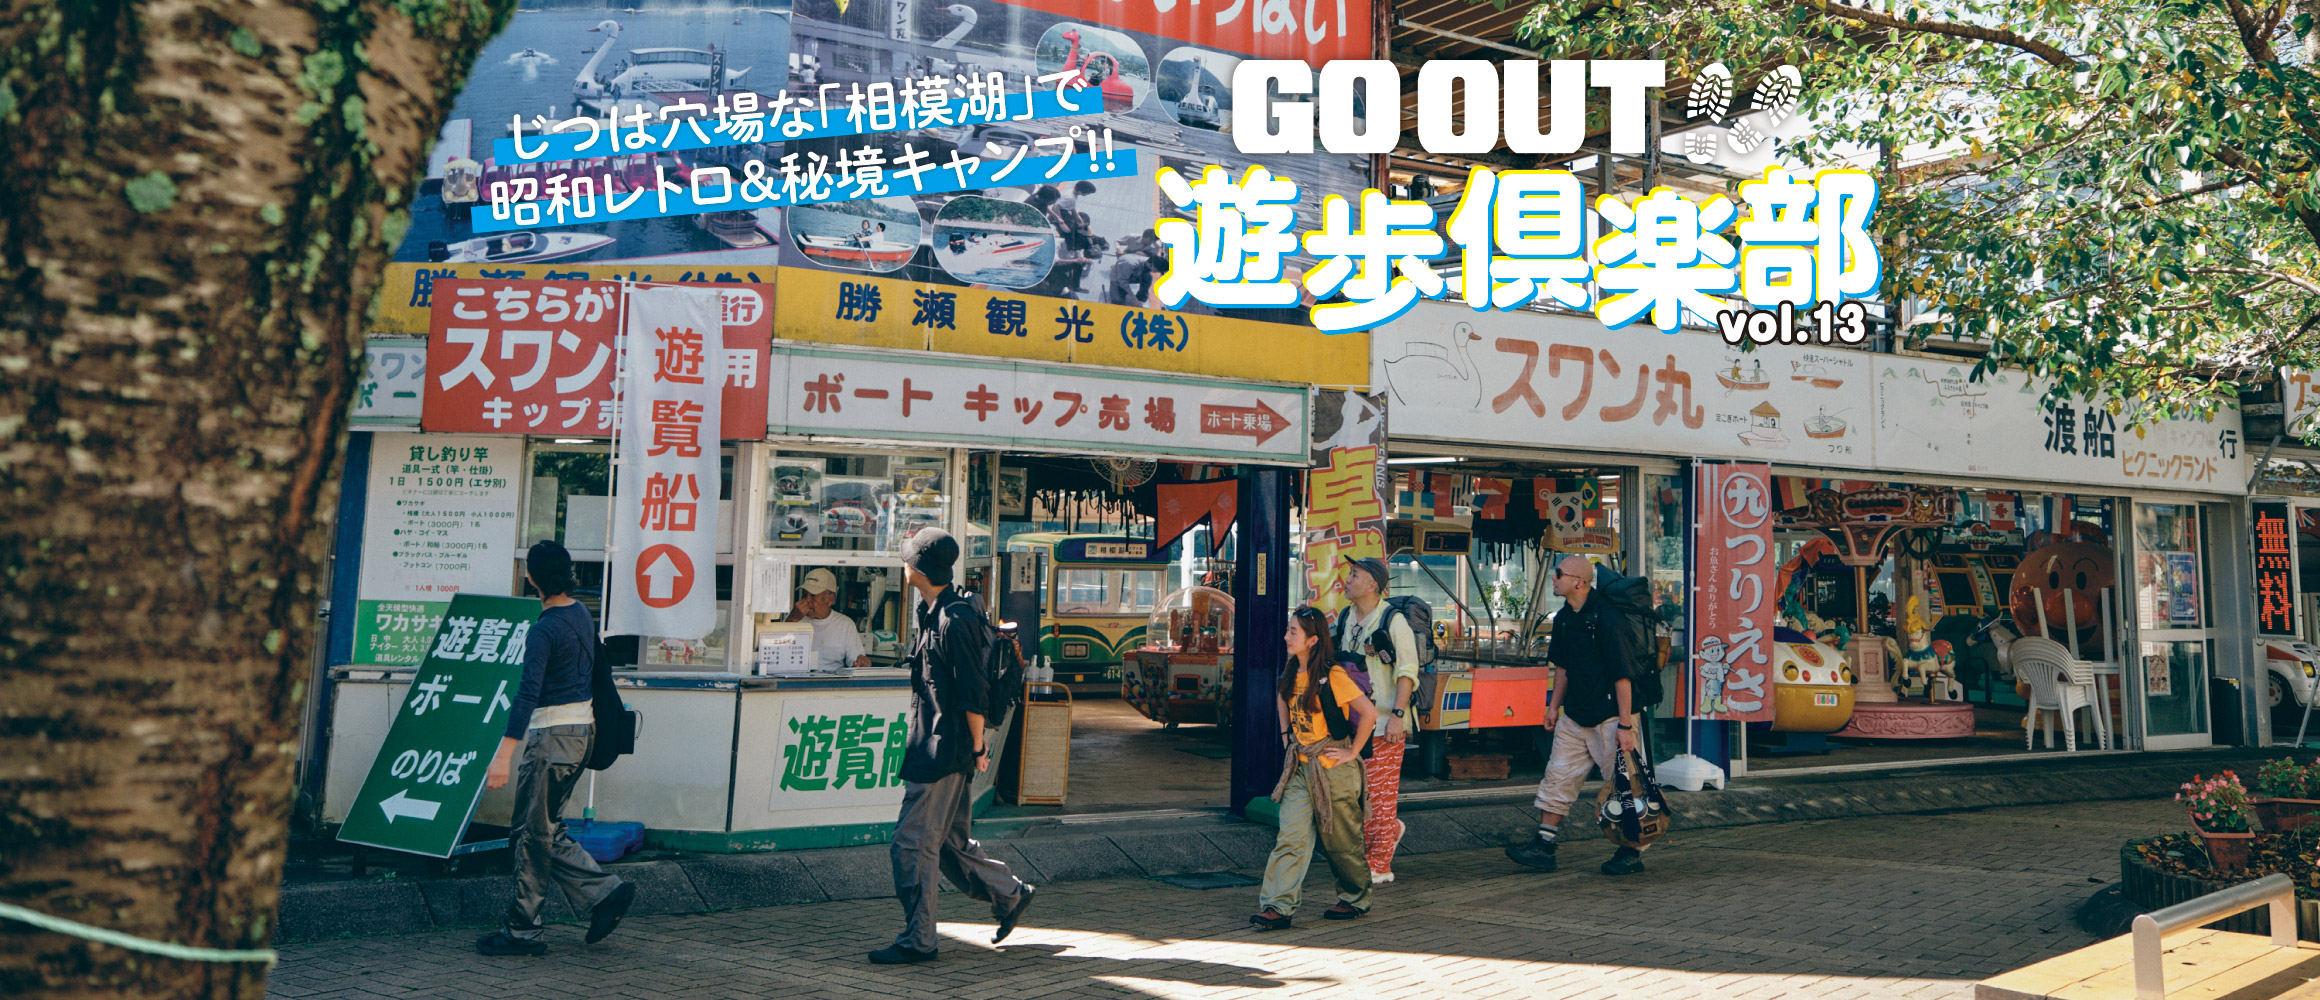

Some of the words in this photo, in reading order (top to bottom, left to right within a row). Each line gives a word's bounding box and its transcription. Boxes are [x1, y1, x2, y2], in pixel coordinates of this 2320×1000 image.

[453, 286, 615, 323] こちらが
[1492, 337, 1705, 430] スワン丸
[803, 372, 933, 418] ボート
[963, 383, 1176, 434] キップ売場
[639, 326, 705, 532] 遊覧船
[1207, 411, 1272, 433] ボート乗場
[2044, 402, 2117, 459] 渡船
[409, 446, 489, 463] 貸し釣り竿
[2219, 429, 2237, 459] 行
[389, 476, 406, 487] 1日
[436, 585, 460, 593] 1000円
[2255, 510, 2293, 631] 無料
[402, 635, 418, 644] 大人
[1726, 533, 1768, 714] つりえさ
[370, 642, 398, 651] ナイター
[402, 643, 418, 652] 大人
[374, 653, 420, 663] 道具レンタル
[409, 674, 512, 724] ボート
[390, 749, 478, 786] のりば
